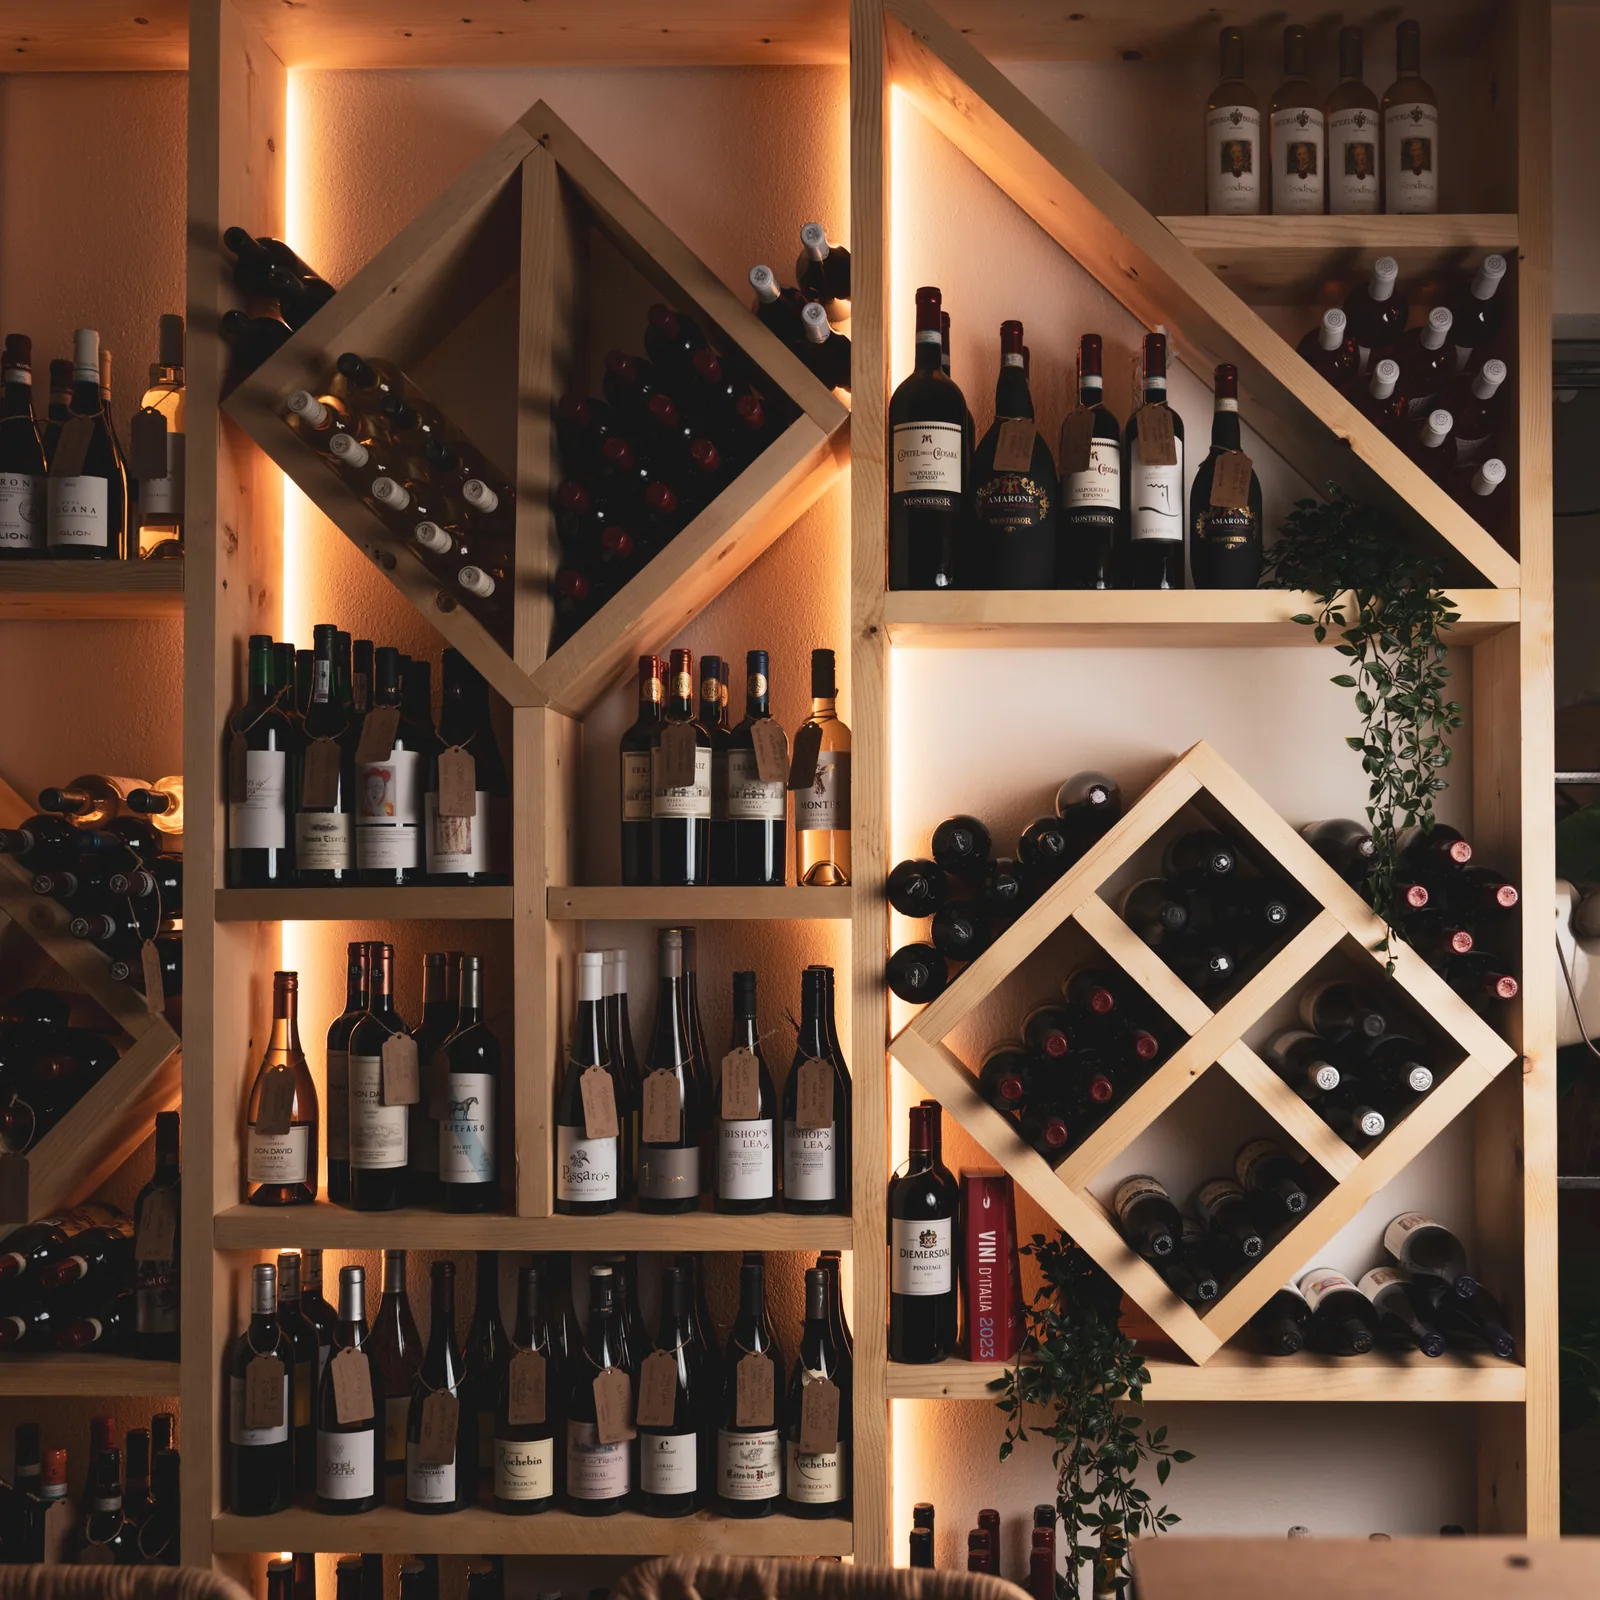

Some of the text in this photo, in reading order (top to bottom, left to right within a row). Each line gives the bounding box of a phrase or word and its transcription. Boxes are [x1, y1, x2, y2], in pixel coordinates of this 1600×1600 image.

[903, 497, 951, 506] MONTRESOR
[988, 495, 1034, 504] AMARONE
[989, 517, 1032, 525] MONTRESOR
[1070, 515, 1115, 524] MONTRESOR
[1210, 517, 1250, 525] AMARONE
[801, 800, 841, 809] MONTES
[724, 1129, 768, 1138] BISHOP'S
[787, 1130, 830, 1139] BISHOP'S
[743, 1140, 770, 1150] LEAP
[803, 1140, 832, 1151] LEAP
[270, 1147, 293, 1155] DAVID
[899, 1247, 951, 1259] DIEMERSDAL
[978, 1230, 997, 1358] VINI D'ITALIA 2023
